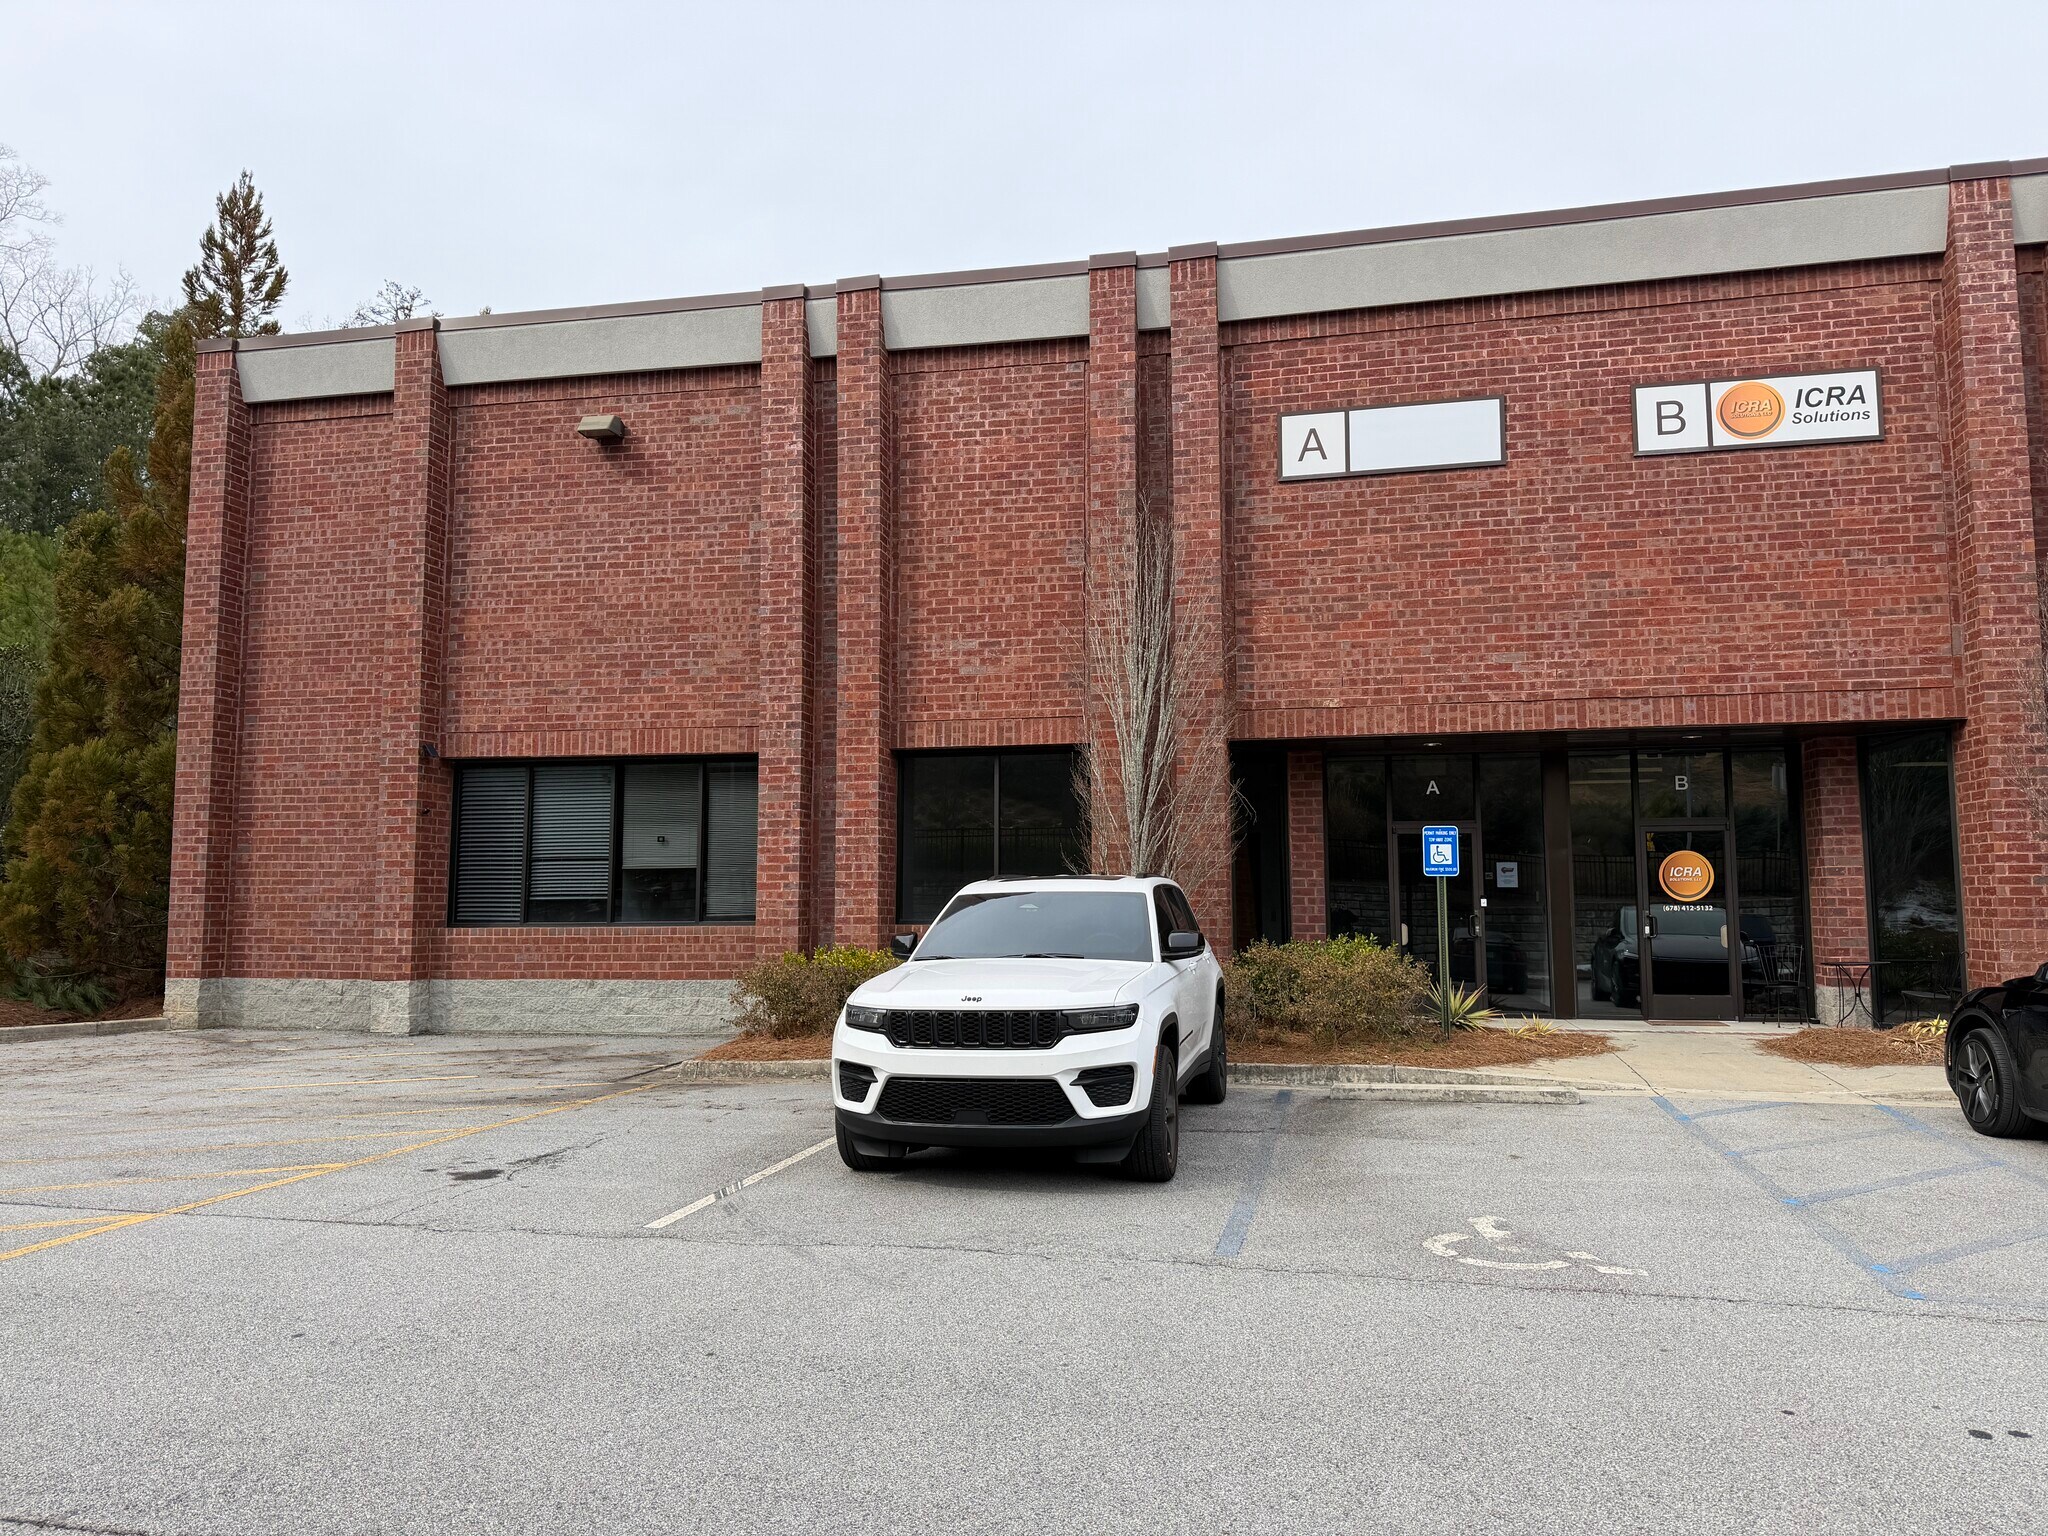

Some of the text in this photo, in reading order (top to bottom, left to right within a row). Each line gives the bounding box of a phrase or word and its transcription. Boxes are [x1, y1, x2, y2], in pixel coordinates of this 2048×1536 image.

[1795, 384, 1866, 409] ICRA
[1731, 398, 1773, 414] ICRA
[1656, 400, 1687, 436] B
[1791, 410, 1871, 425] Solutions
[1298, 427, 1328, 462] A
[1426, 780, 1440, 795] A
[1675, 775, 1689, 790] B
[1670, 866, 1702, 877] ICRA
[960, 995, 983, 1003] Jeep
